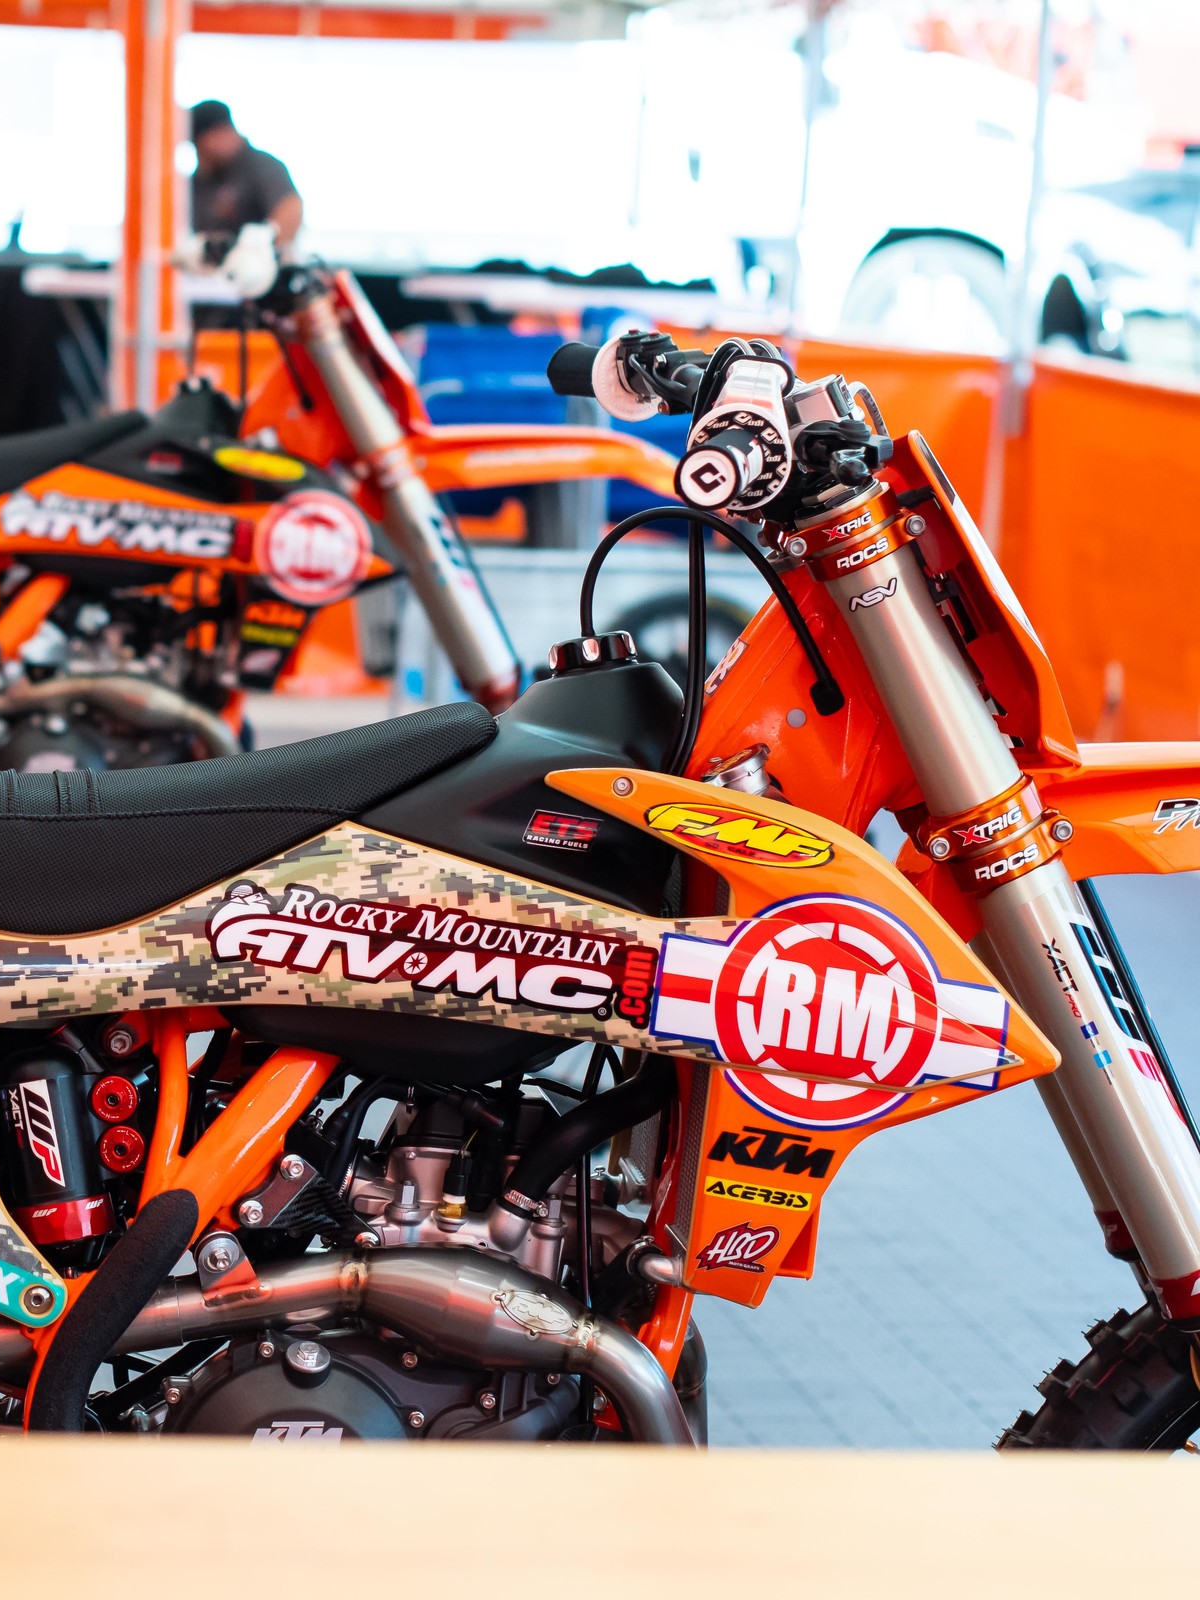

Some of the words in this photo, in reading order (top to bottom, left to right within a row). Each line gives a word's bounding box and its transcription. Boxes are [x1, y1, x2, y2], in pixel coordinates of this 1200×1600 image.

[822, 511, 873, 542] XTRIG
[836, 537, 890, 569] ROCS
[850, 578, 897, 612] ASV
[526, 834, 561, 845] RACING
[562, 840, 589, 849] FUELS
[649, 806, 833, 857] FMF
[953, 805, 1023, 847] XTRIG
[975, 843, 1040, 881] ROCS
[277, 888, 407, 933] ROCKY
[411, 909, 620, 967] MOUNTAIN
[1041, 937, 1079, 992] XACT
[621, 949, 654, 1024] .com
[759, 956, 900, 1064] RM
[8, 1088, 24, 1130] XACT
[707, 1126, 836, 1179] KTM
[32, 1207, 58, 1218] WP
[85, 1199, 104, 1210] WP
